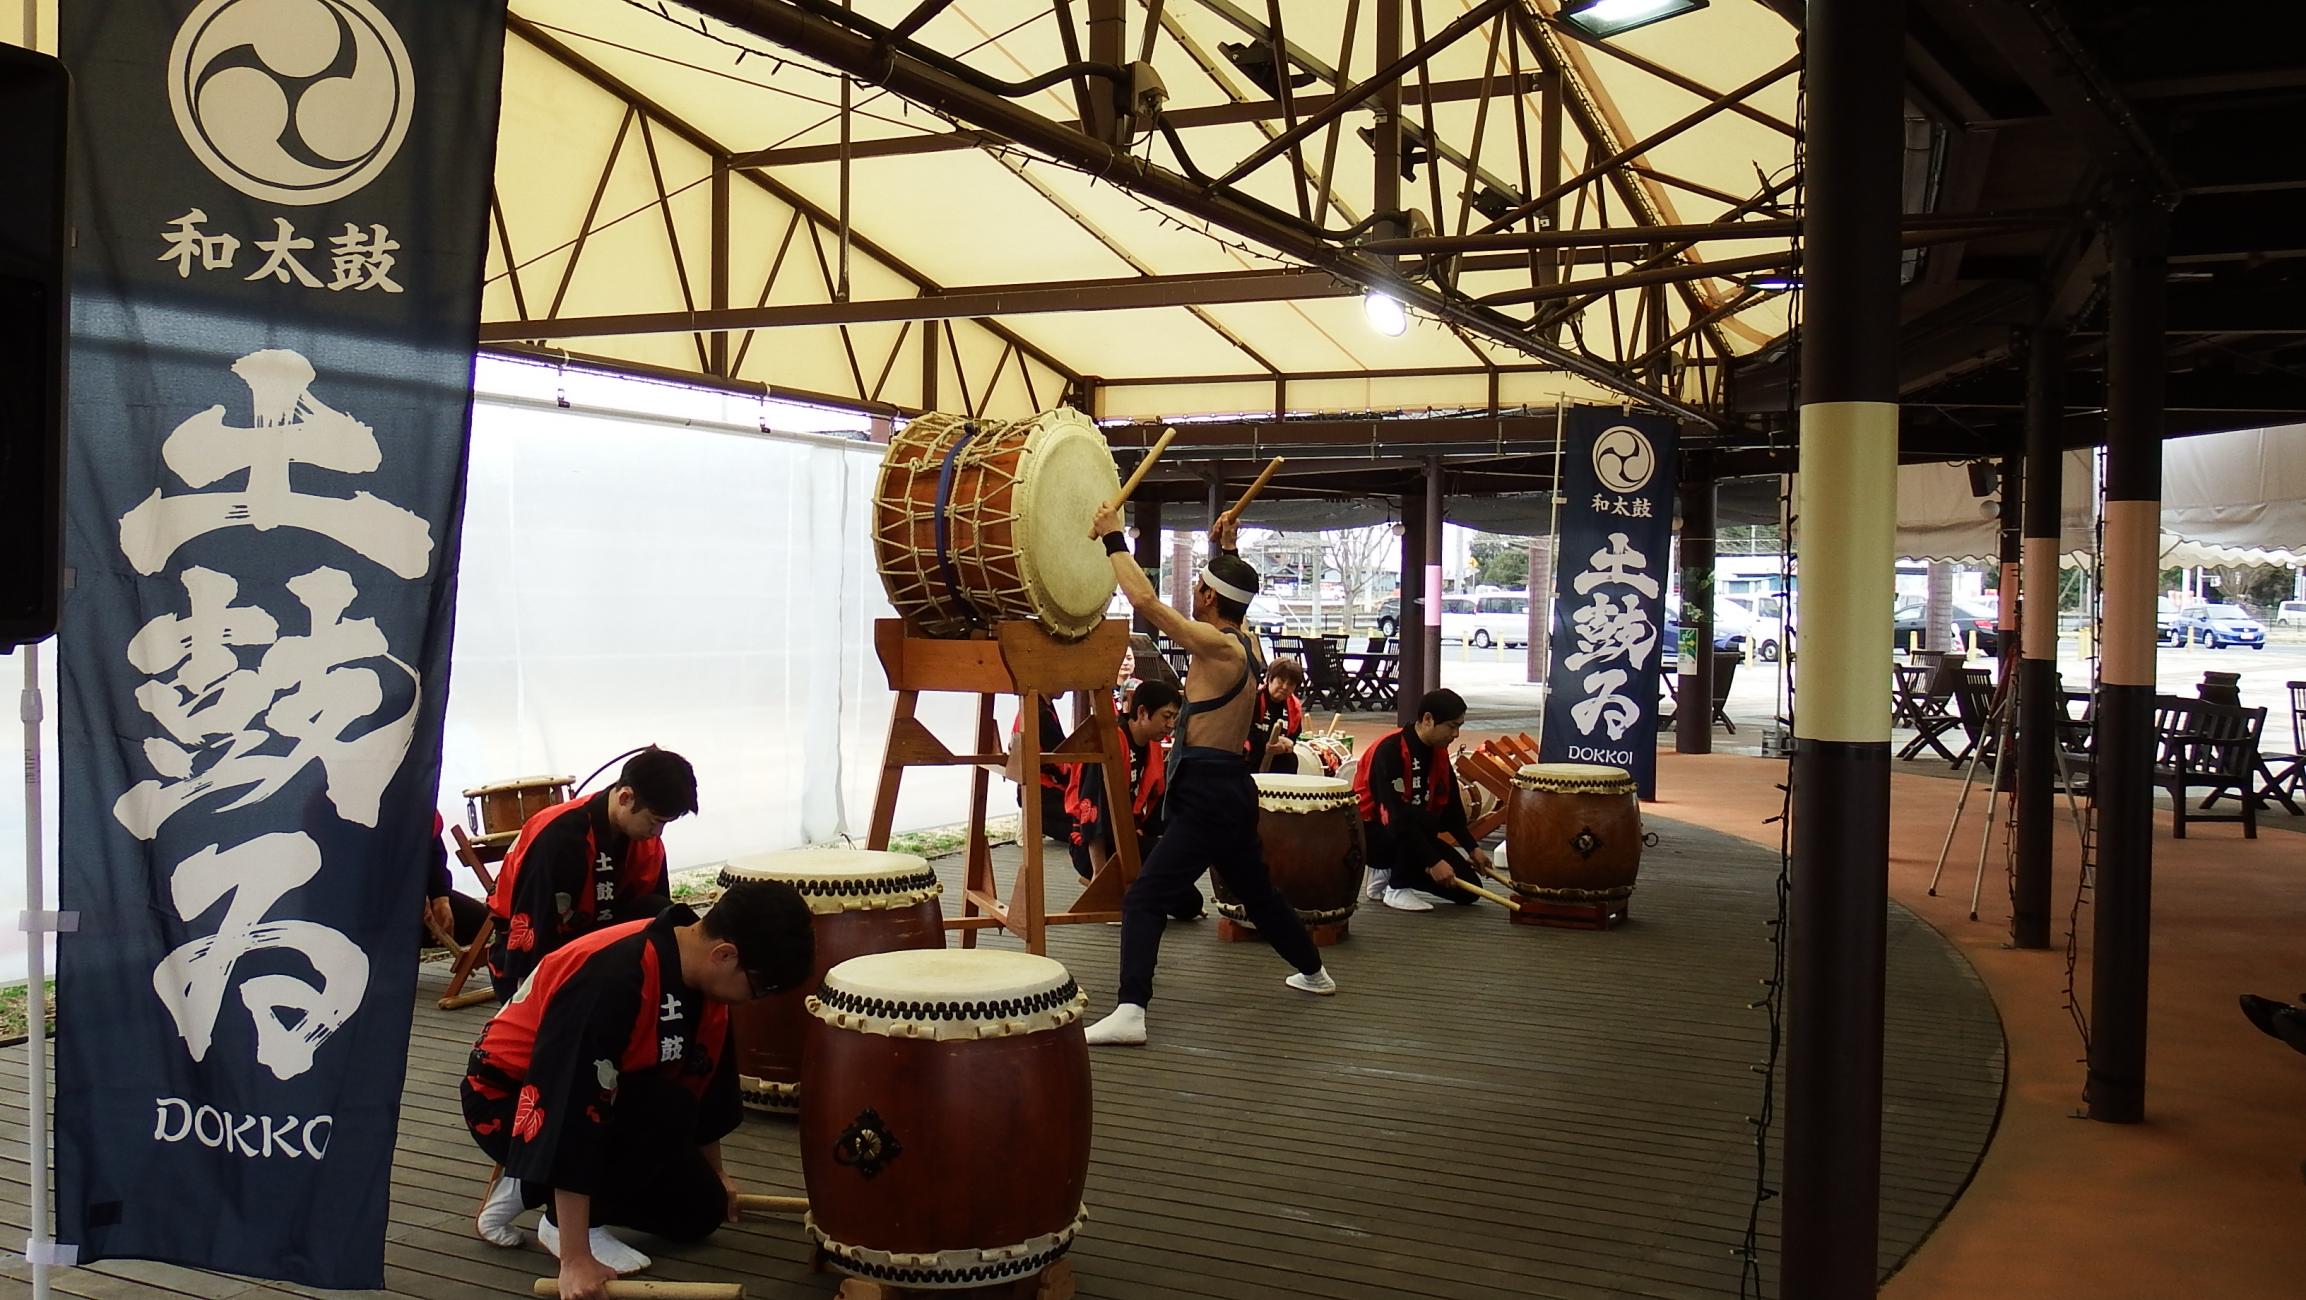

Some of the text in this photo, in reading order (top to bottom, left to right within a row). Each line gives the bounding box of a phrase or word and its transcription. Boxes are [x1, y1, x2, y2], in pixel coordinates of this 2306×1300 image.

[157, 207, 405, 293] 和太鼓
[1591, 493, 1653, 518] 和太鼓
[1568, 745, 1633, 766] DOKKOI
